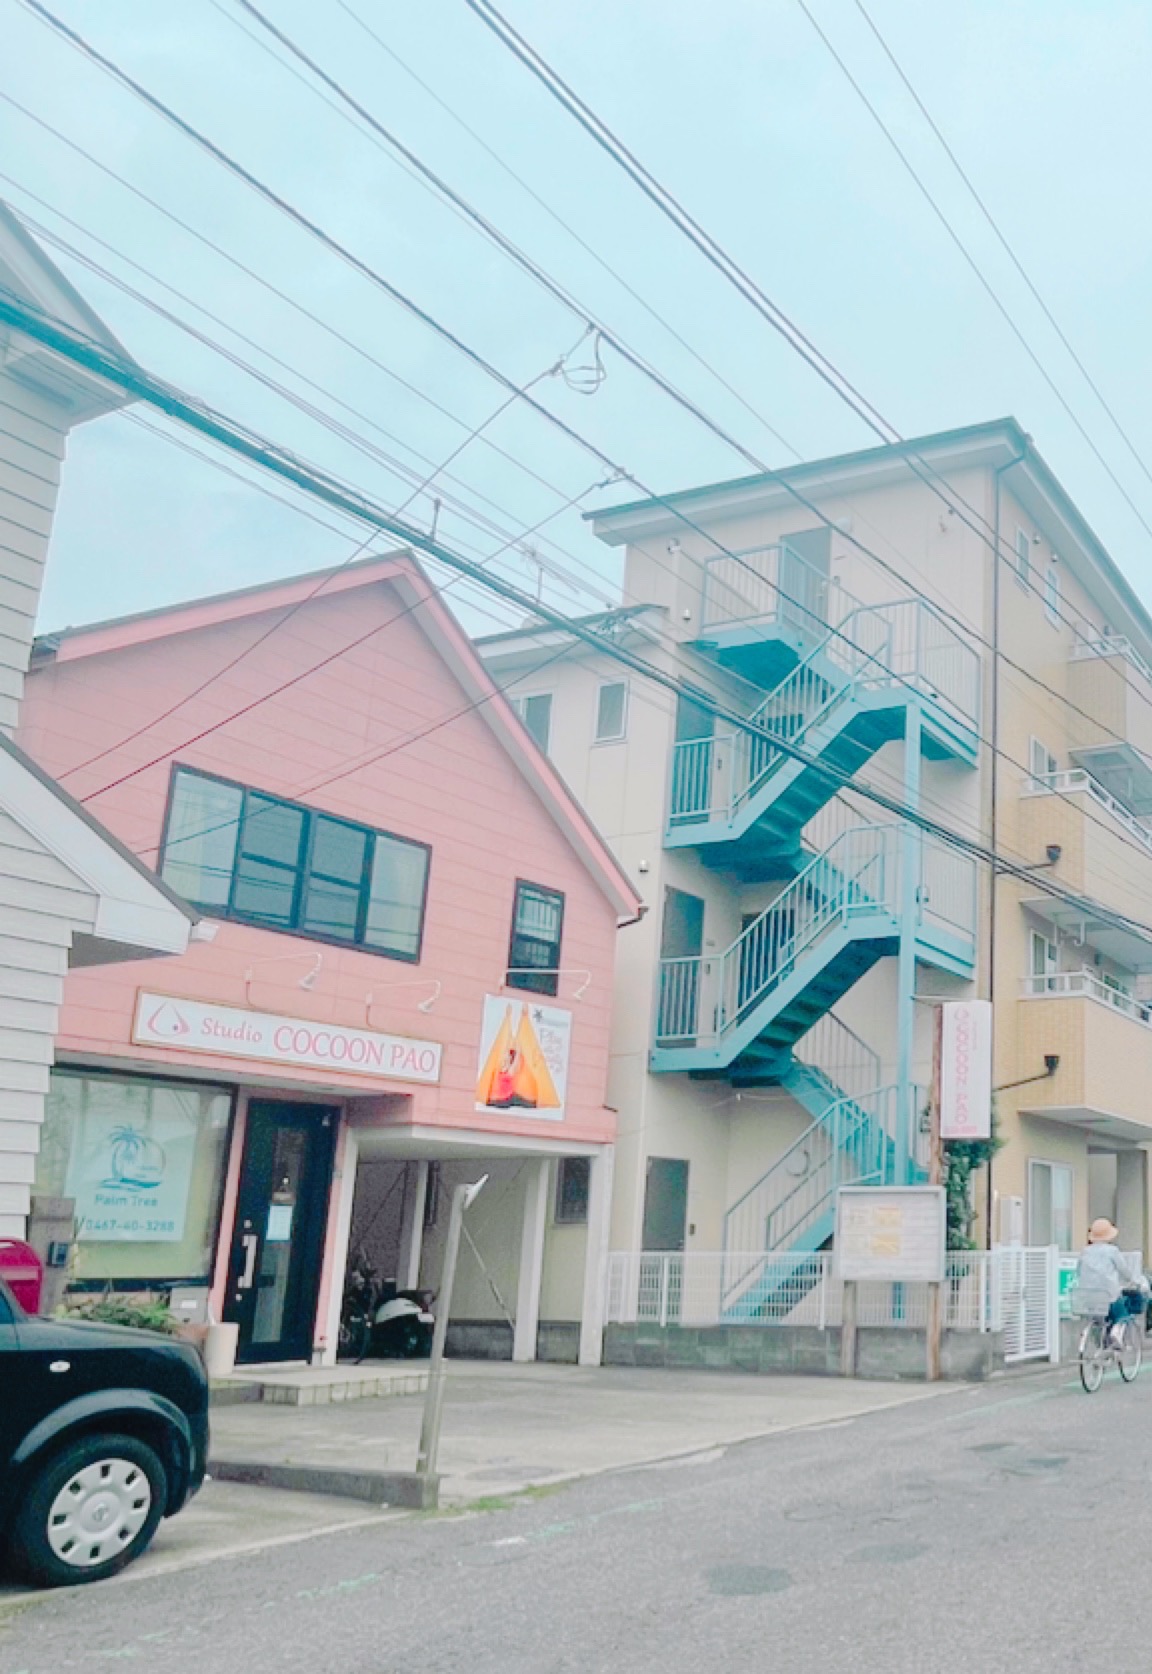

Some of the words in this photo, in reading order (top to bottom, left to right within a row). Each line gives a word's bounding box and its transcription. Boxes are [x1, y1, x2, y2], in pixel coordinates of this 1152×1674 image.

[202, 1018, 262, 1042] Studio
[274, 1026, 385, 1066] COCOON
[390, 1044, 435, 1073] PAO
[95, 1193, 128, 1206] Palm
[131, 1195, 158, 1207] Tree
